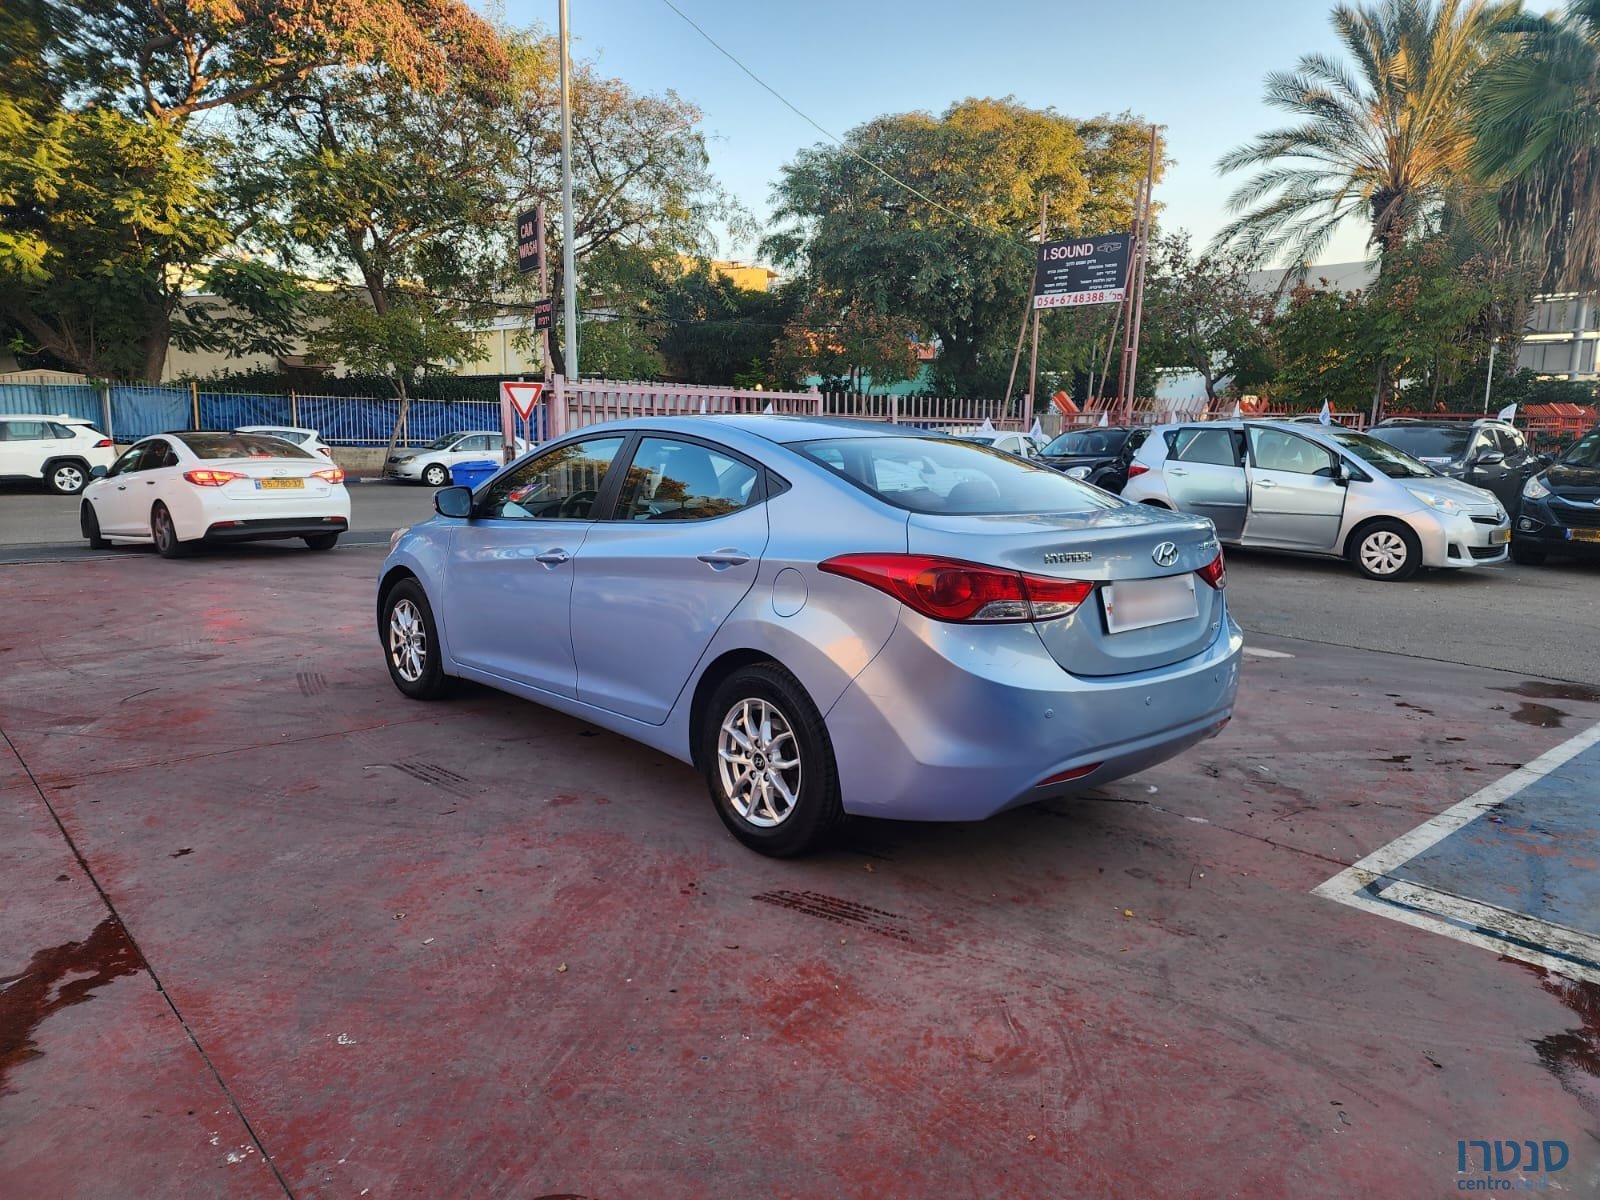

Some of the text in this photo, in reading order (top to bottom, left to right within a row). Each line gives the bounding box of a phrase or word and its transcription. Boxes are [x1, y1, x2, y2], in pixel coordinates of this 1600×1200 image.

[520, 222, 533, 239] CAR
[519, 240, 538, 258] WASH
[1043, 243, 1094, 261] I.SOUND
[1037, 291, 1105, 306] 054-6748388
